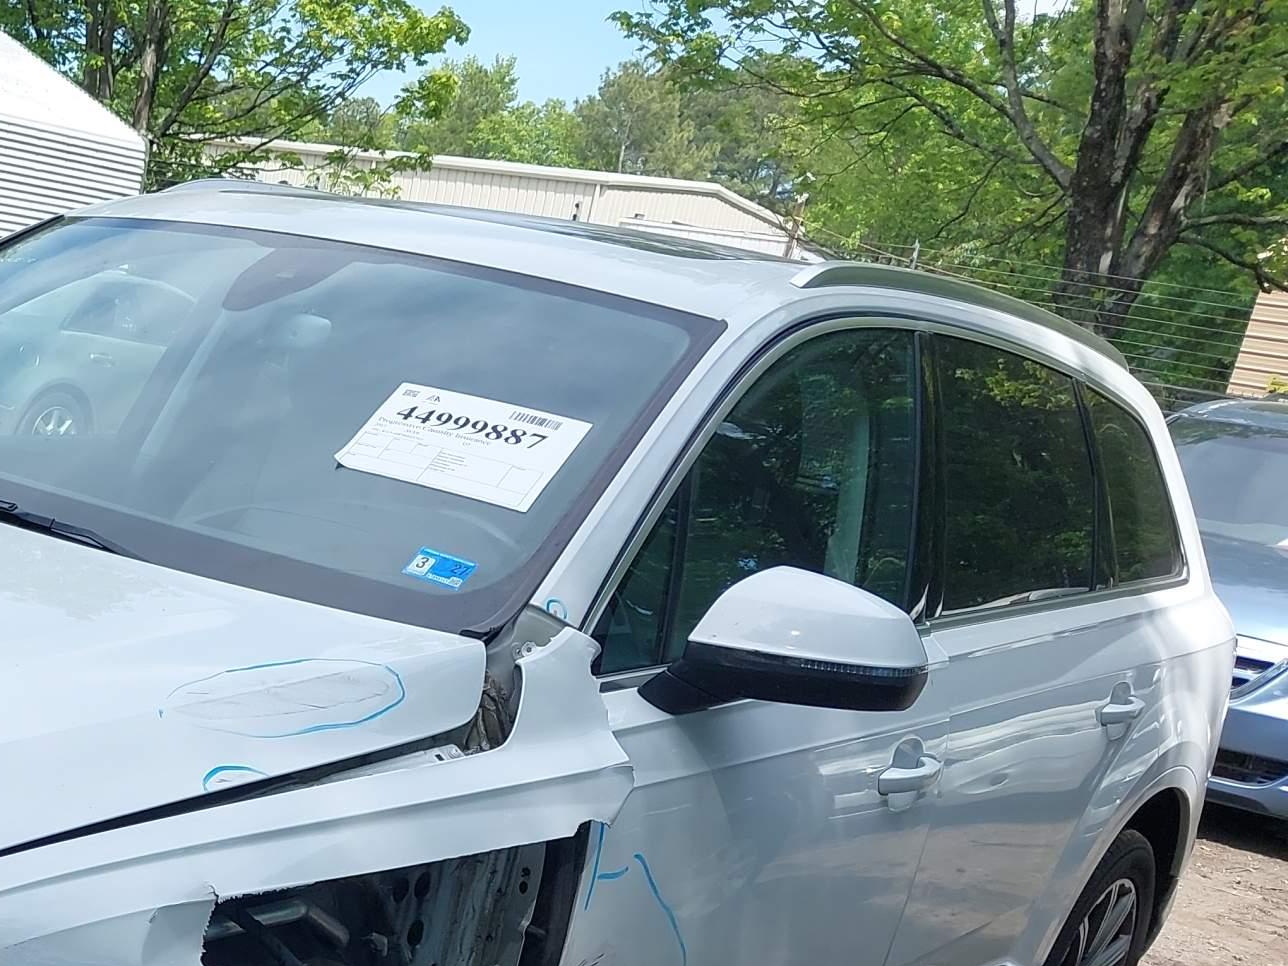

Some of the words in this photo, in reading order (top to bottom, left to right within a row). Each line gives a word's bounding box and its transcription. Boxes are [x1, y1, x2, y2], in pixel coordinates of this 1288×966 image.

[396, 405, 548, 449] 44999887
[415, 556, 430, 569] 3
[450, 563, 471, 576] 27
